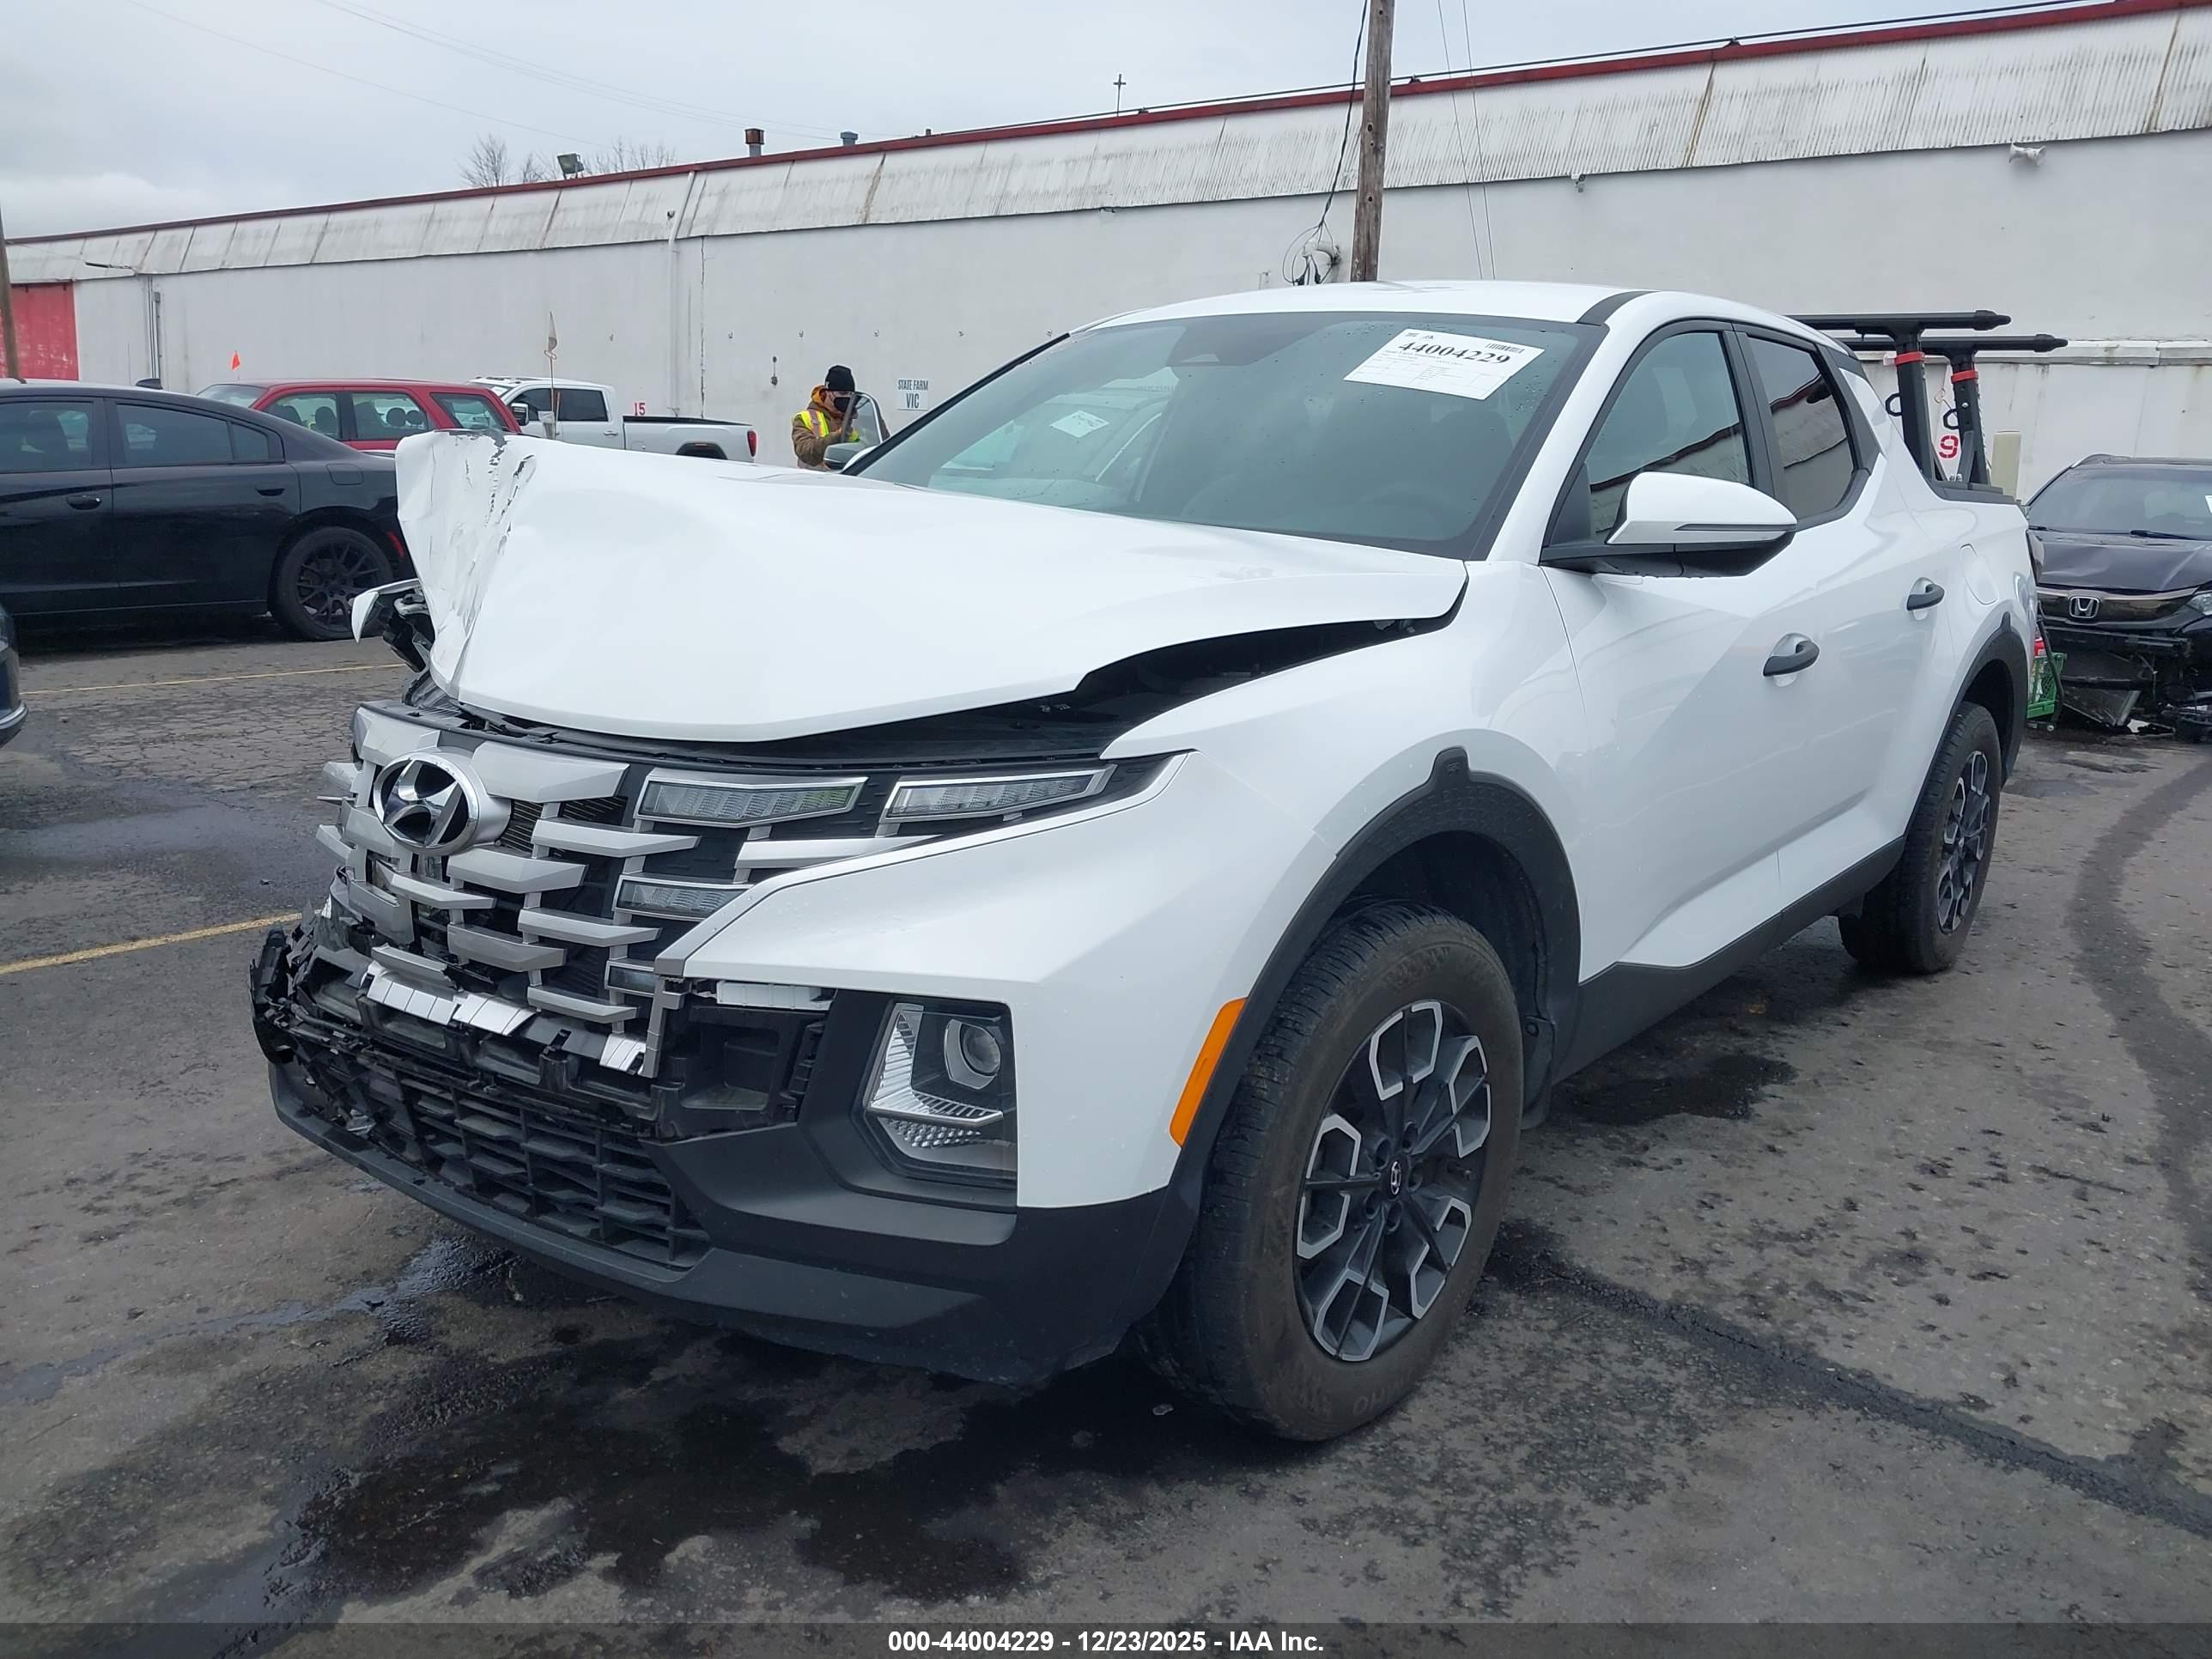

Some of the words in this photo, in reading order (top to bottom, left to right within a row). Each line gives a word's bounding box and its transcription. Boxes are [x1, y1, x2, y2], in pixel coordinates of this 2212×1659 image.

[1397, 341, 1511, 364] 44004229
[897, 379, 912, 391] STATE
[913, 380, 929, 391] FARM
[634, 402, 646, 416] 15
[906, 392, 920, 409] VIC
[1938, 434, 1959, 459] 9
